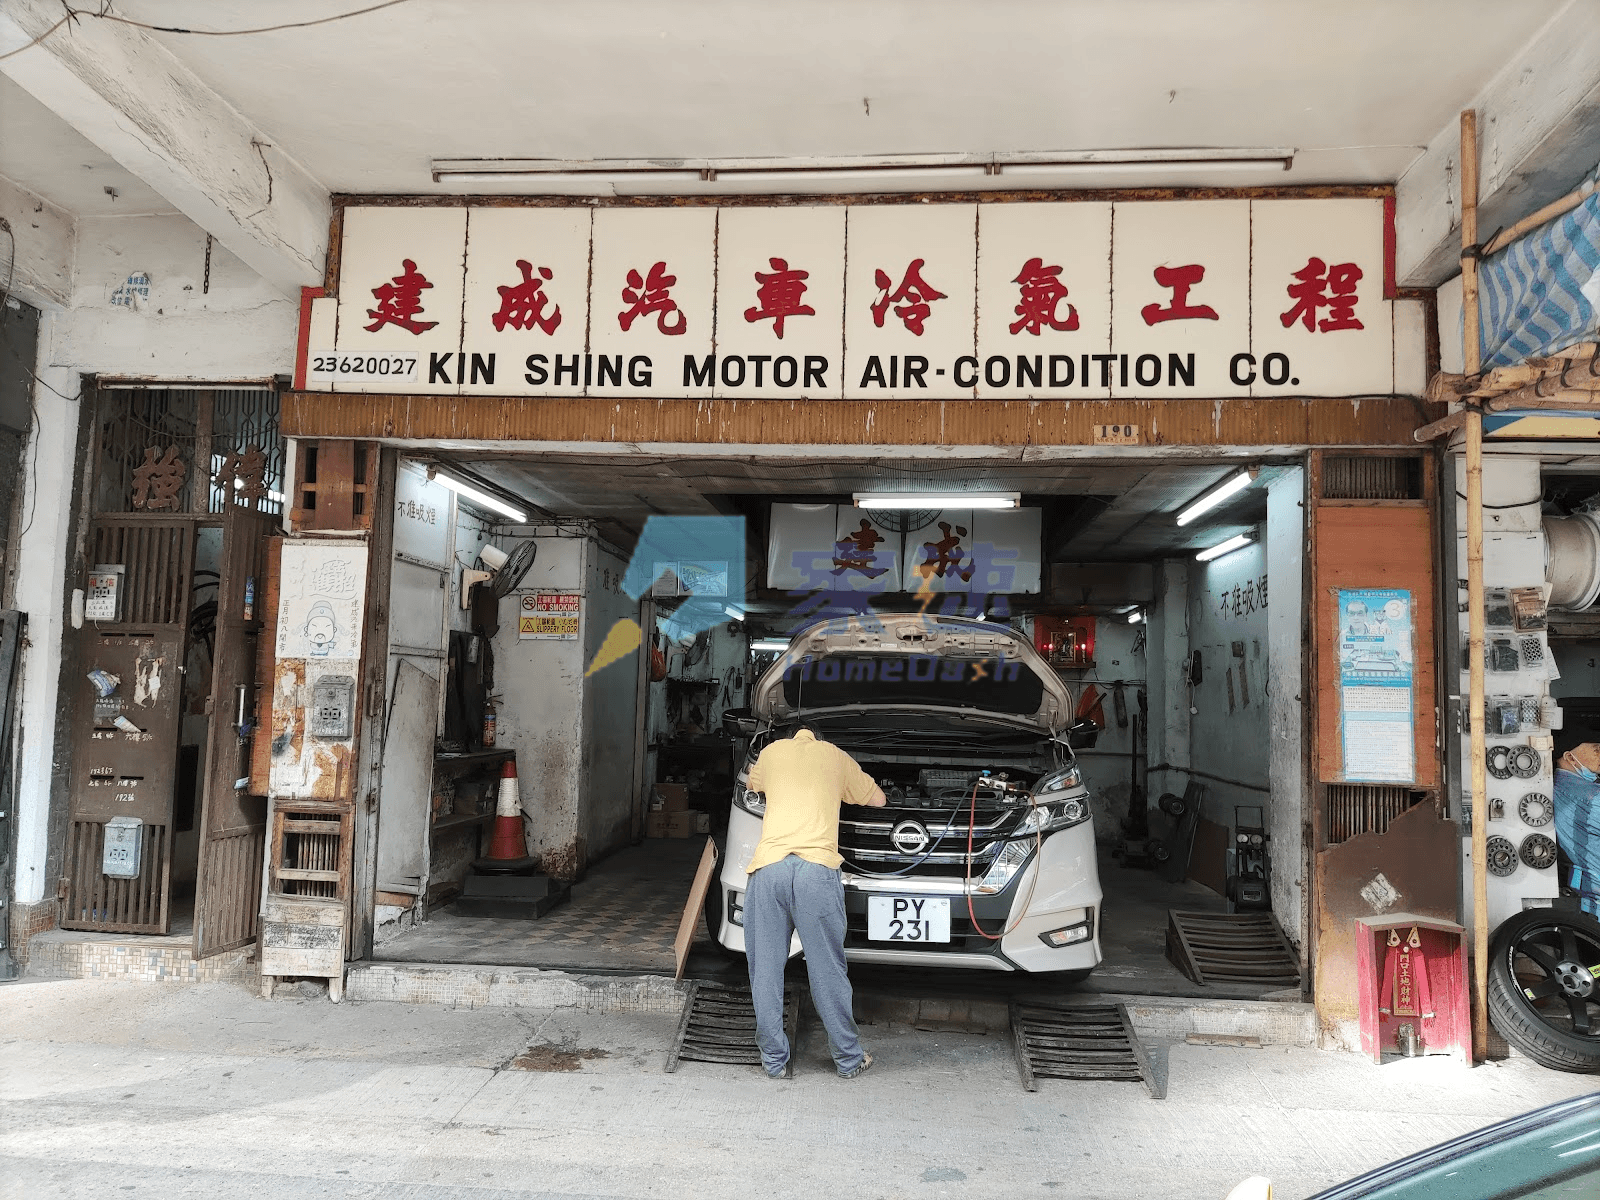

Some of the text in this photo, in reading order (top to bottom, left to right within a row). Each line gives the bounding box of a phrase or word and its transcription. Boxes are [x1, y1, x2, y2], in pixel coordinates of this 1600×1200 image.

[363, 257, 1364, 340] 建成汽車冷氣工程
[313, 355, 417, 378] 23620027
[428, 351, 1300, 389] KIN SHING MOTOR AIR-CONDITION CO.
[830, 519, 976, 582] 建成
[537, 603, 579, 611] NO SMOKING
[894, 834, 925, 842] NISSAN
[893, 898, 926, 920] PY
[888, 919, 930, 941] 231
[1399, 953, 1412, 1007] 門口土地財神
